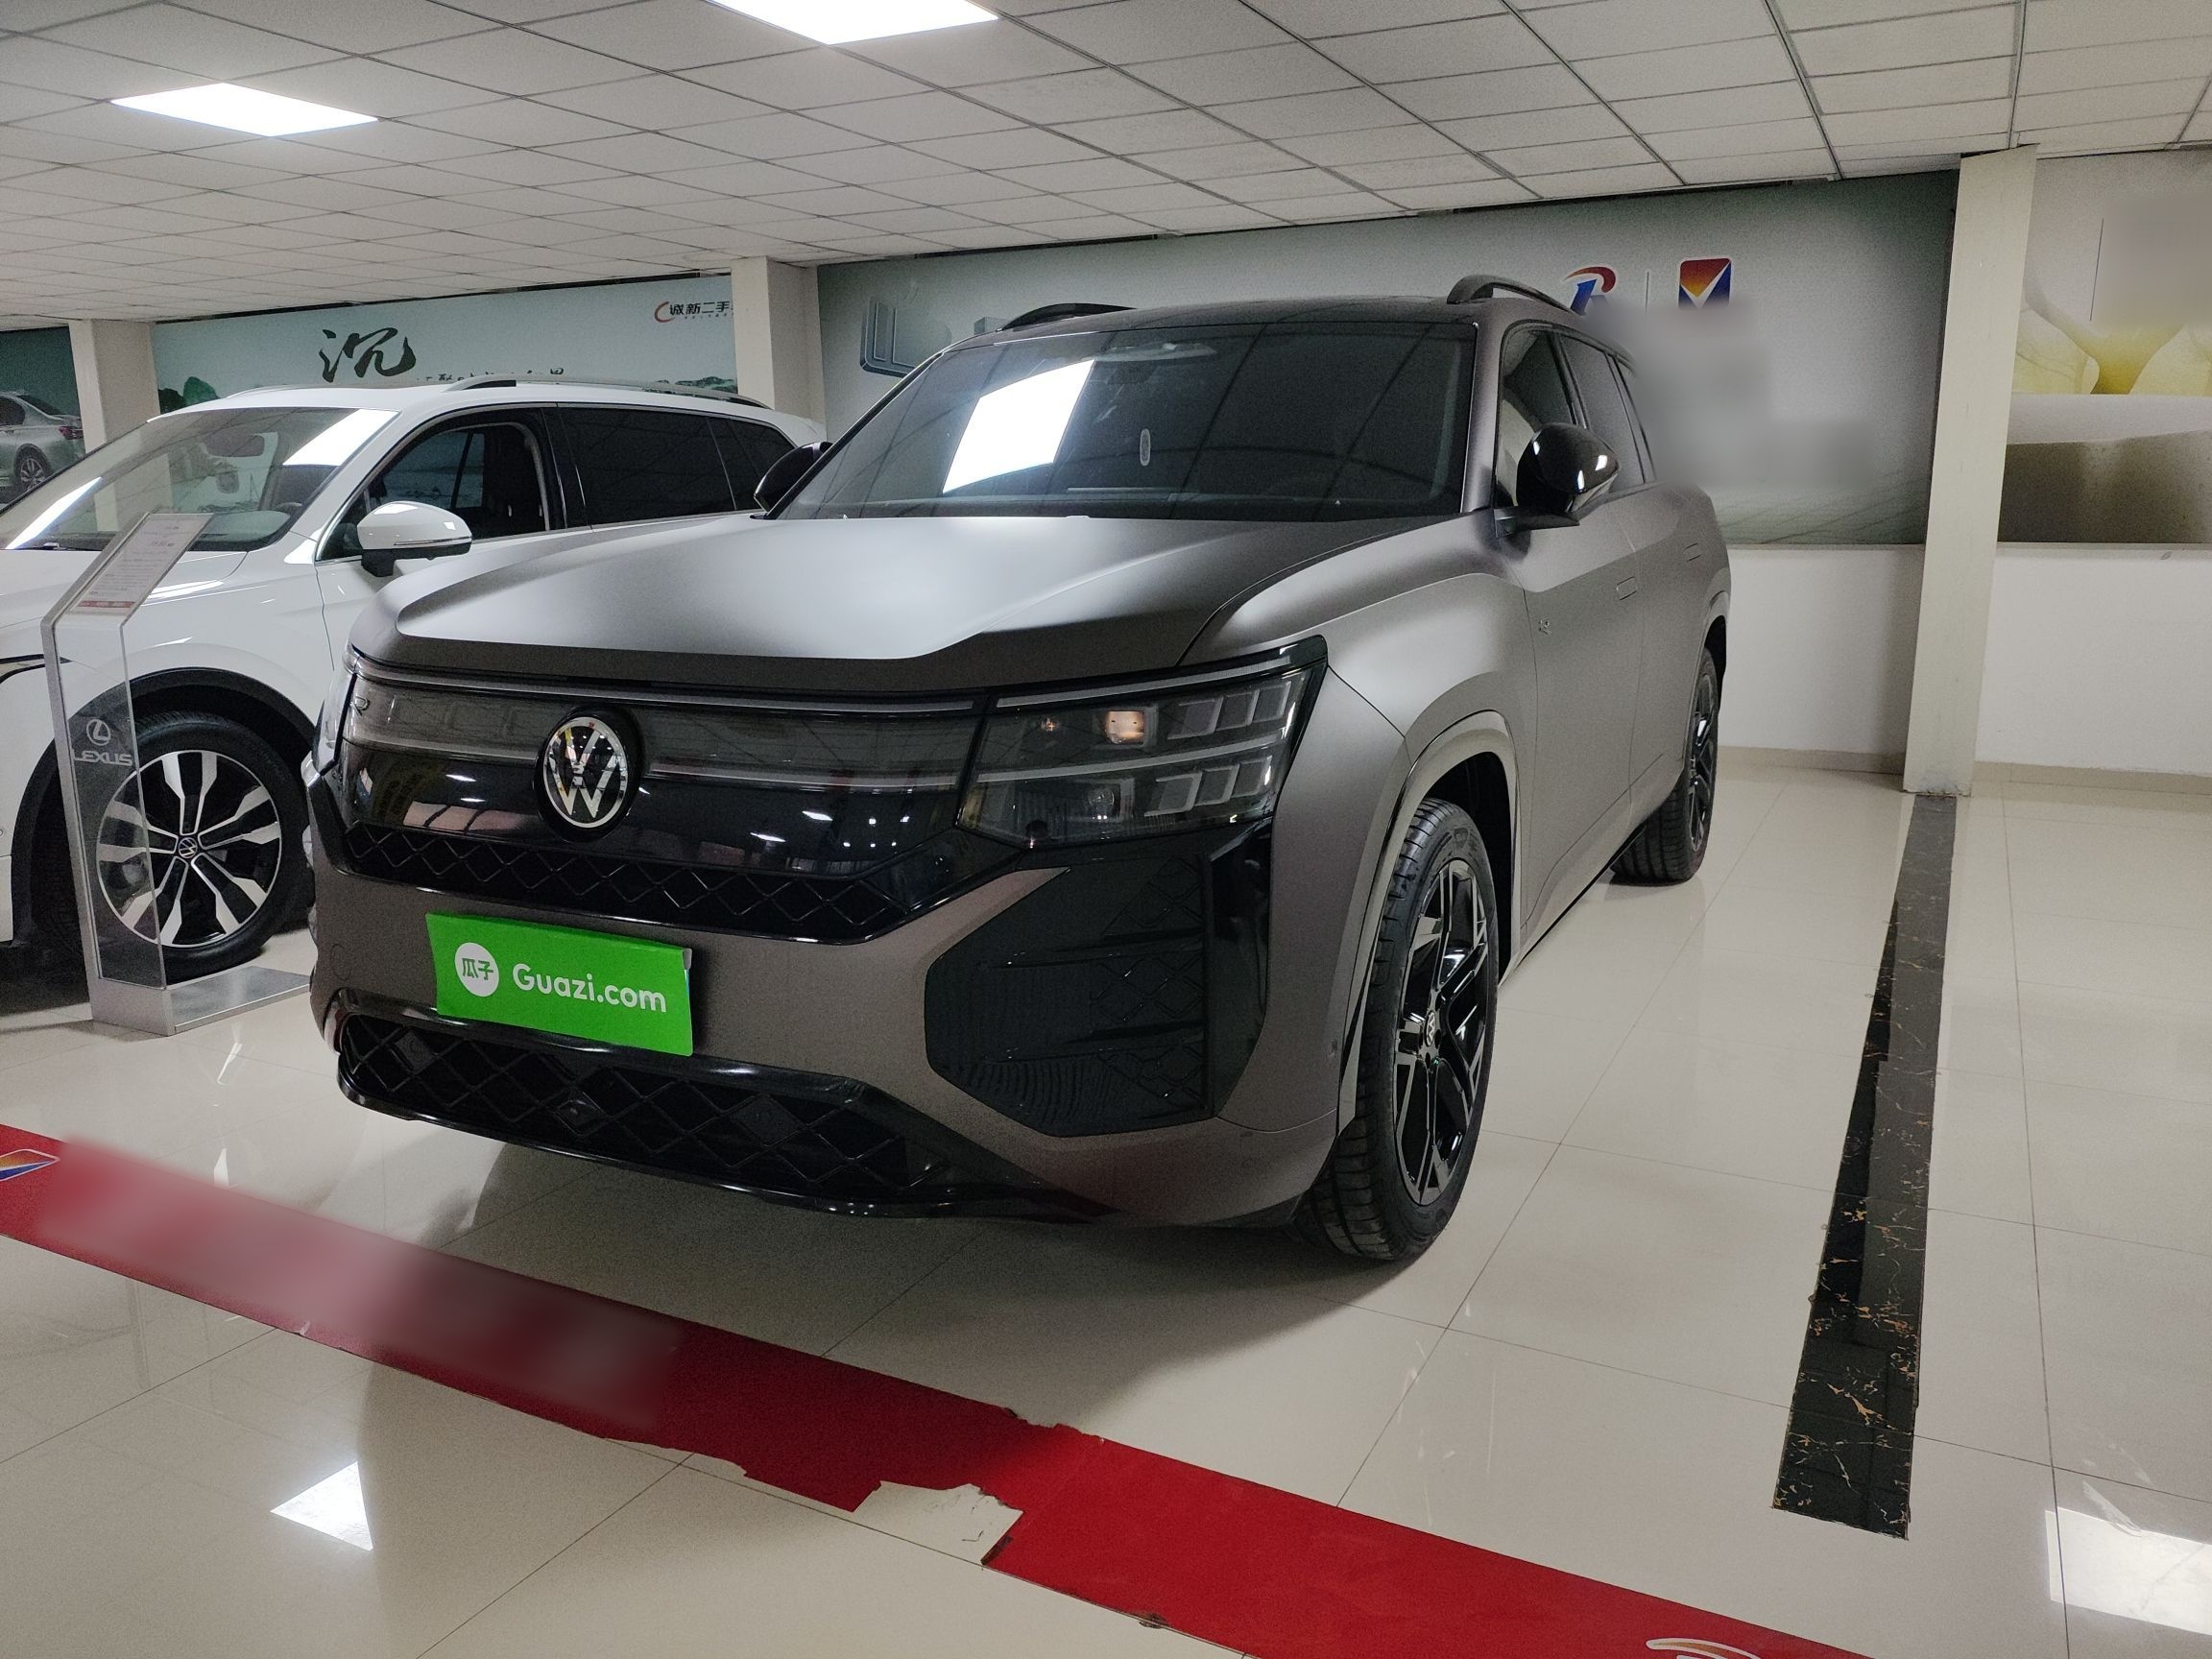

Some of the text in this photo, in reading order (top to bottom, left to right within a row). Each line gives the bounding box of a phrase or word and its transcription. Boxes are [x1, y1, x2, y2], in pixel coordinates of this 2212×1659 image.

[669, 301, 733, 316] 诚新二手
[73, 750, 132, 766] LEXUS
[461, 957, 493, 981] 瓜子
[512, 963, 667, 1013] Guazi.com
